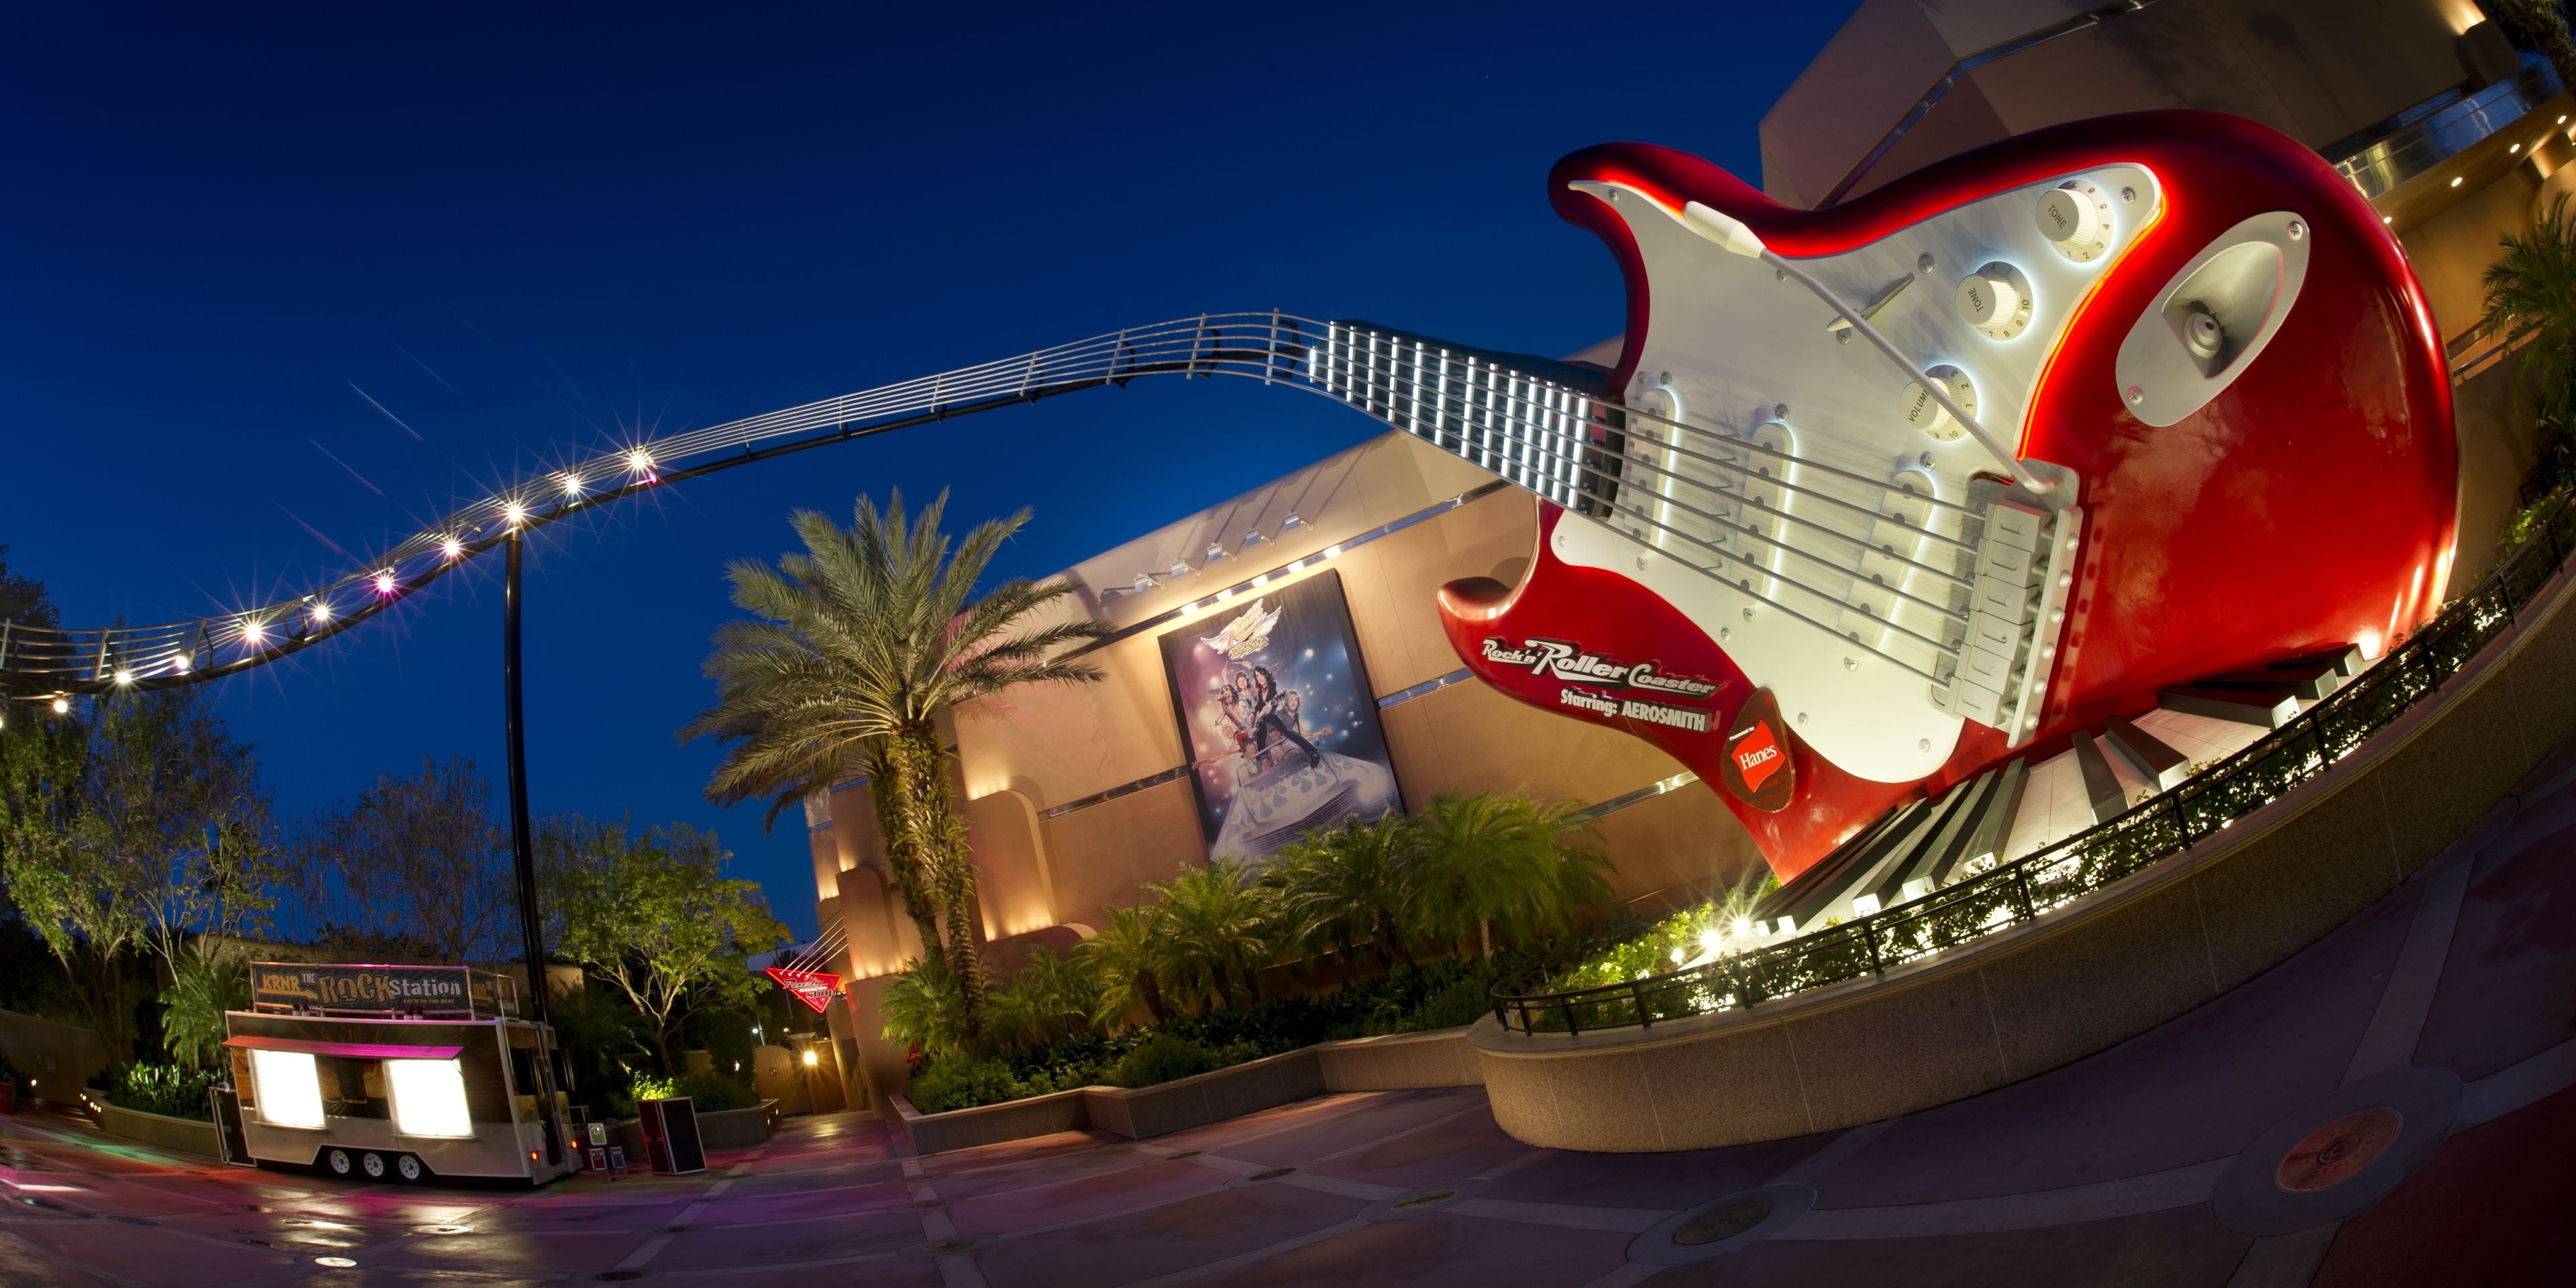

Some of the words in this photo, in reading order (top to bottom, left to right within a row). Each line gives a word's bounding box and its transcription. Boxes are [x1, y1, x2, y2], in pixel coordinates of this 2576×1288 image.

[2047, 203, 2067, 229] TONE
[2082, 252, 2090, 260] 2
[1968, 287, 1984, 313] TONE
[2022, 299, 2030, 310] 10
[1948, 430, 1958, 439] 10
[1524, 639, 1630, 684] Roller
[1627, 663, 1717, 696] Coaster
[1560, 688, 1618, 718] Starring:
[1621, 700, 1707, 732] AEROSMITH
[1739, 745, 1777, 771] Hanes
[262, 974, 301, 992] KRNR
[302, 973, 316, 984] THE
